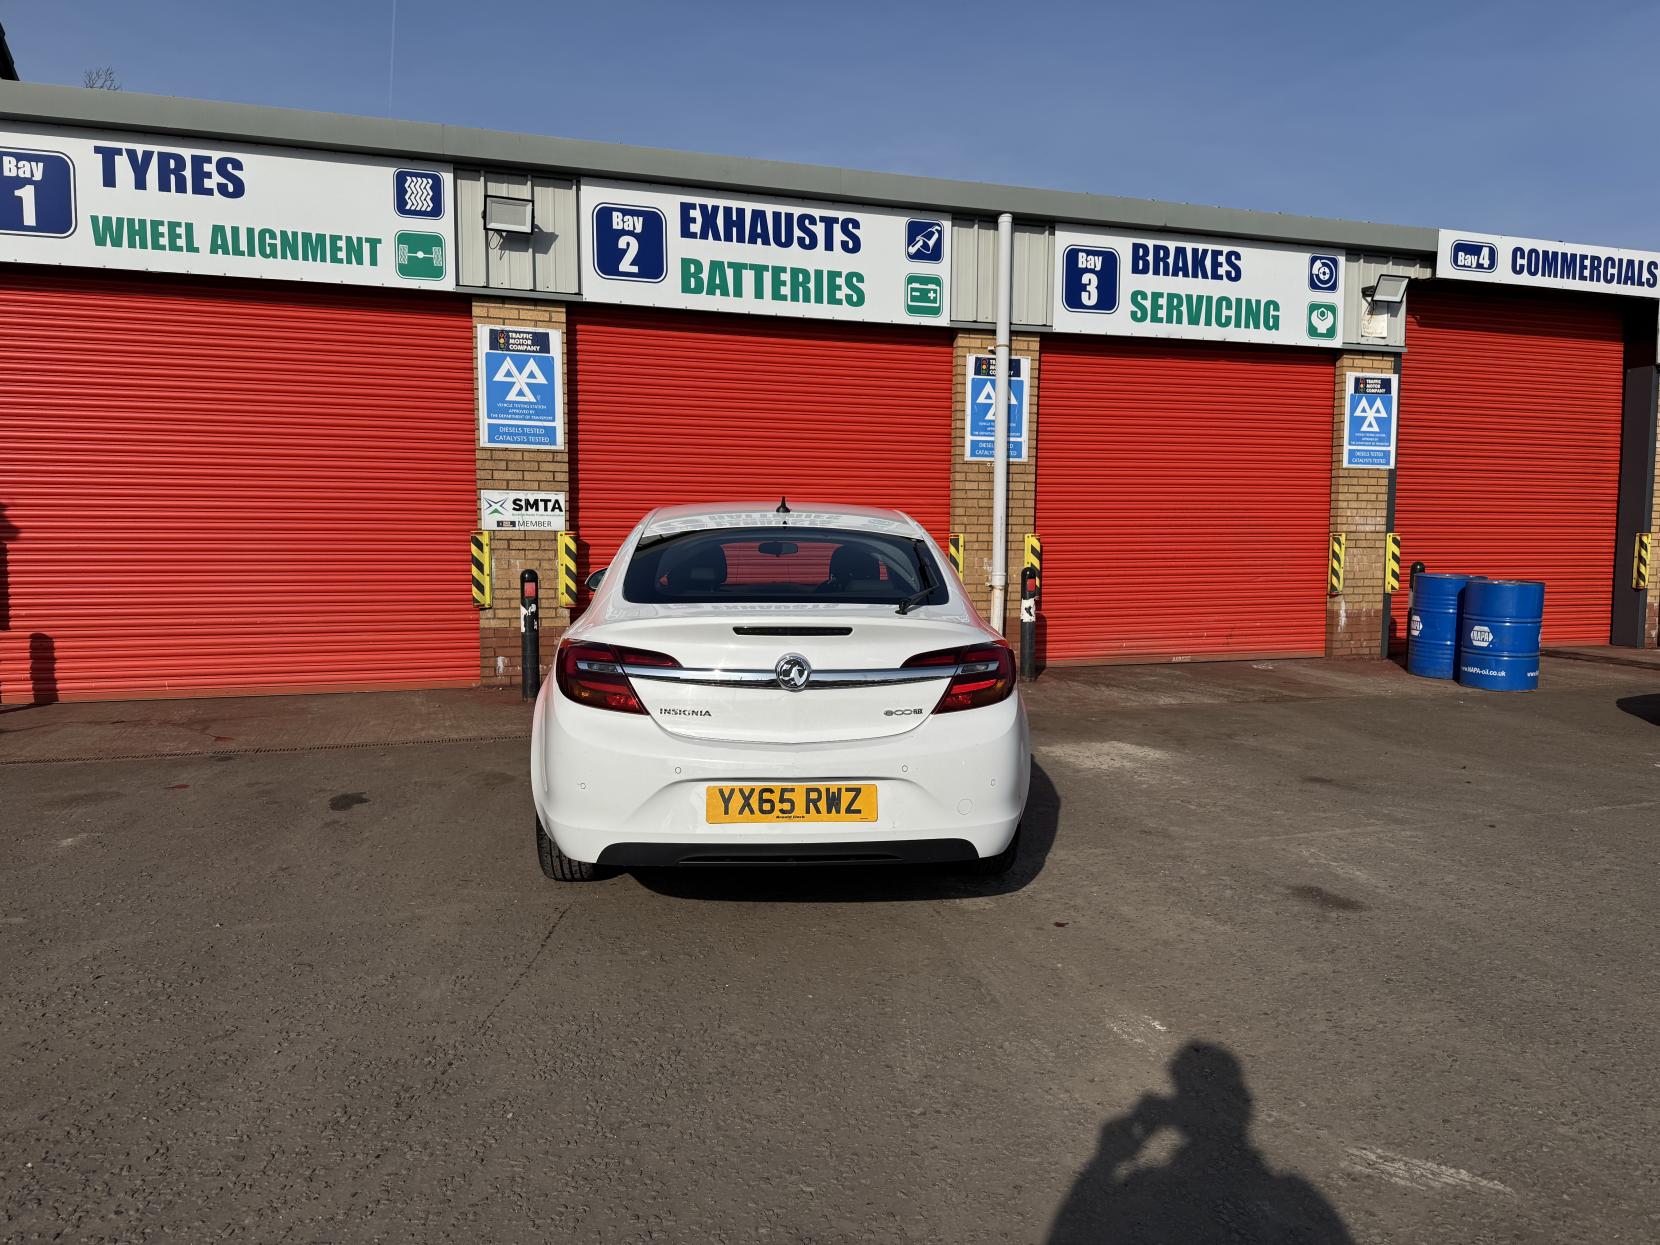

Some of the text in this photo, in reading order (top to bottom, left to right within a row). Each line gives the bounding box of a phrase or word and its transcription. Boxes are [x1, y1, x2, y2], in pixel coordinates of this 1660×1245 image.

[2, 156, 44, 181] Bay
[93, 145, 246, 199] TYRES
[14, 184, 37, 226] 1
[612, 211, 643, 233] Bay
[90, 215, 382, 267] WHEEL ALIGNMENT
[680, 202, 862, 254] EXHAUSTS
[618, 235, 639, 273] 2
[1078, 252, 1102, 271] Bay
[1131, 243, 1242, 282] BRAKES
[1511, 246, 1659, 289] COMMERCIALS
[681, 258, 866, 307] BATTERIES
[1081, 273, 1098, 306] 3
[1130, 290, 1280, 331] SERVICING
[512, 499, 563, 512] SMTA
[1471, 629, 1488, 642] NAPA
[659, 708, 712, 717] INSIGNIA
[718, 787, 862, 815] YX65 RWZ
